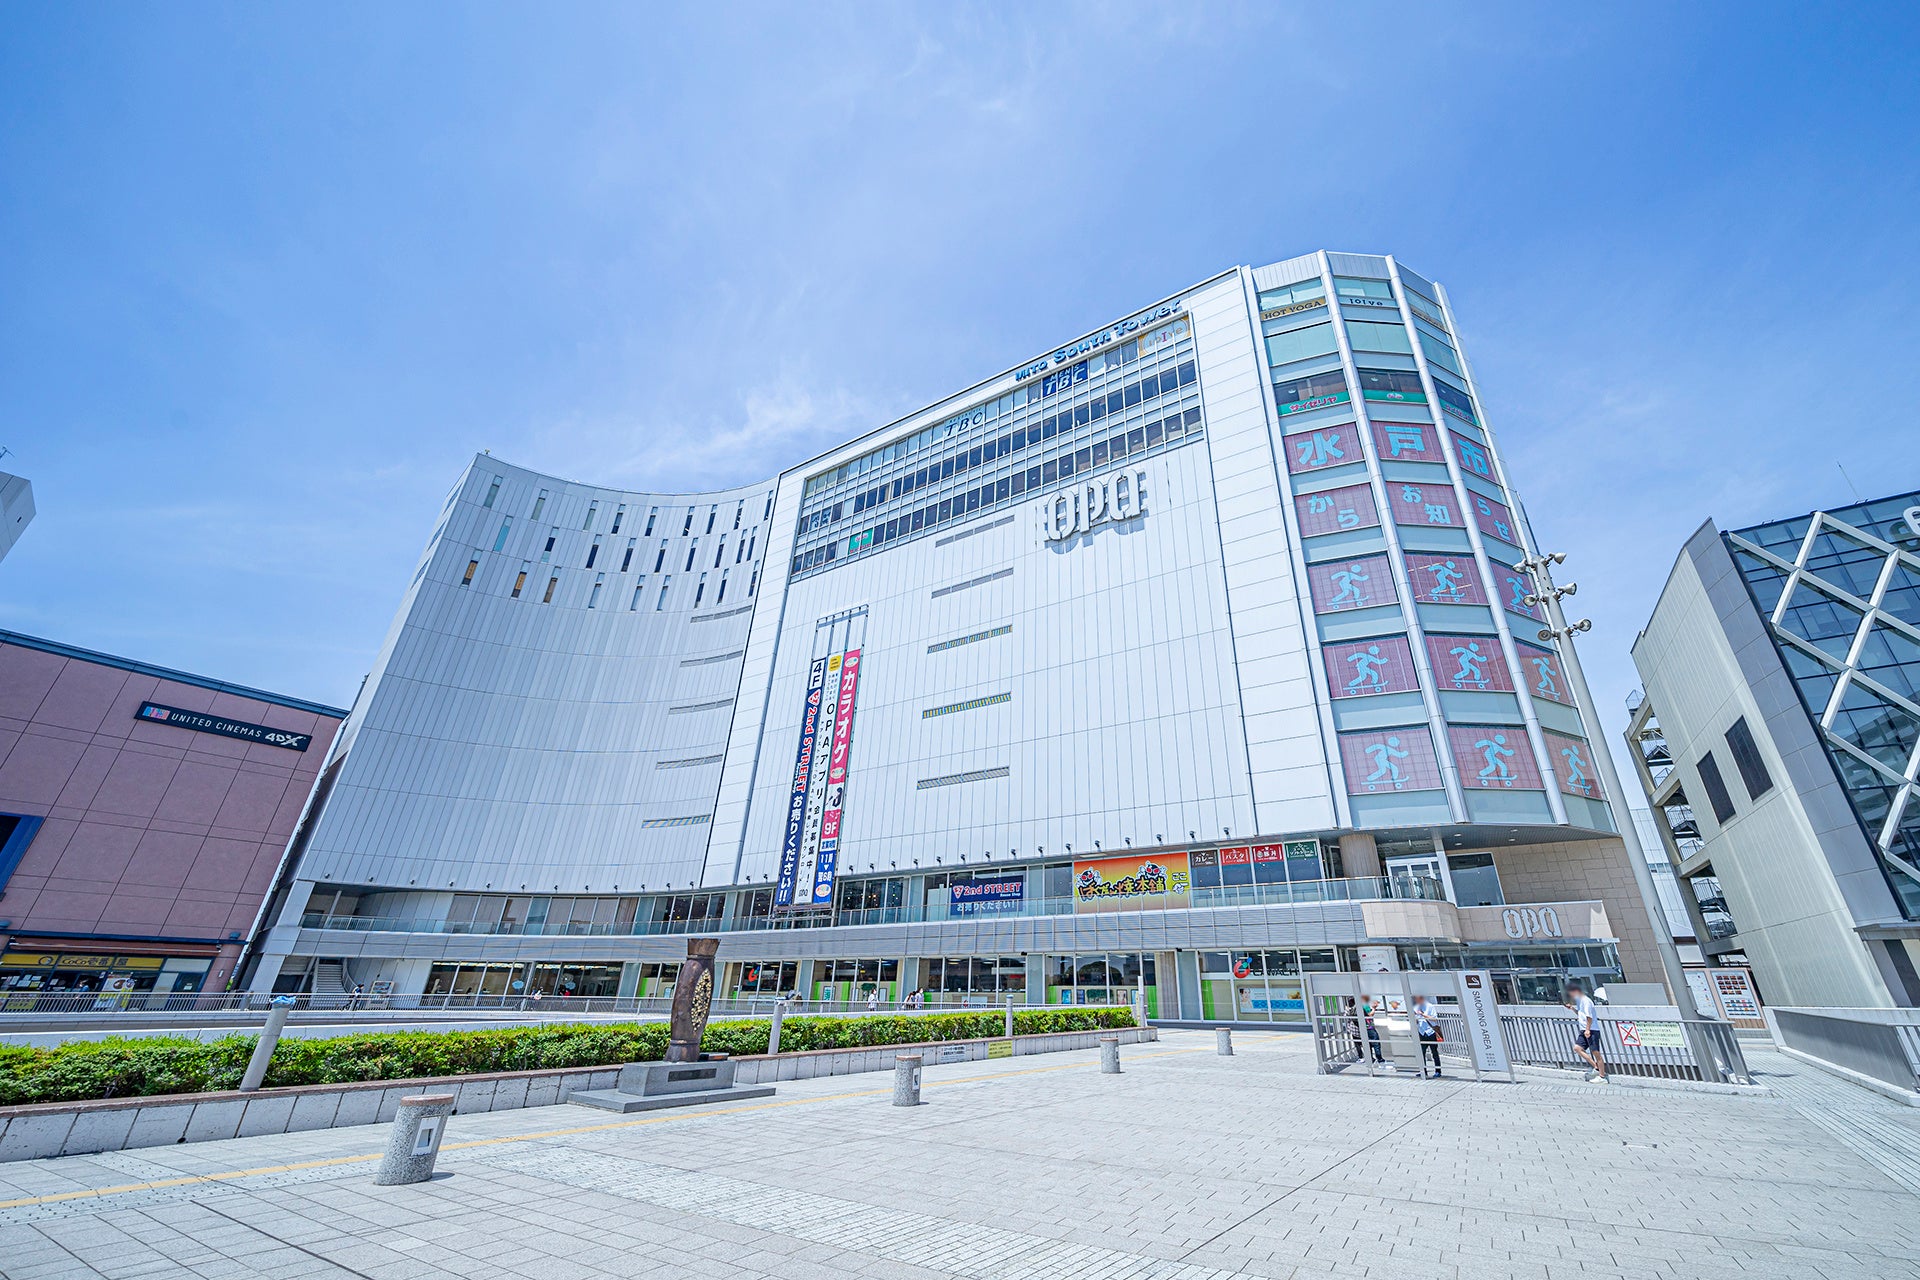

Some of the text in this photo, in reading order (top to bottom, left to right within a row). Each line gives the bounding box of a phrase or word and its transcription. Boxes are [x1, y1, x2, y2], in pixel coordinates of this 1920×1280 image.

[1264, 300, 1322, 320] HOT YOGA
[1053, 329, 1111, 363] South
[1113, 299, 1181, 336] Tower
[1045, 367, 1087, 395] TBC
[1289, 395, 1337, 413] サイゼリヤ
[945, 411, 983, 437] TBC
[812, 662, 823, 687] 4F
[171, 712, 304, 747] UNITED CINEMAS 4DX
[805, 706, 817, 735] 2nd
[834, 670, 855, 764] カラオケ
[796, 736, 813, 793] STREET
[824, 822, 837, 835] 9F
[1195, 854, 1214, 863] カレー
[963, 882, 1022, 896] 2nd STREET
[1472, 990, 1488, 1028] SMOKING
[1481, 1028, 1492, 1050] AREA
